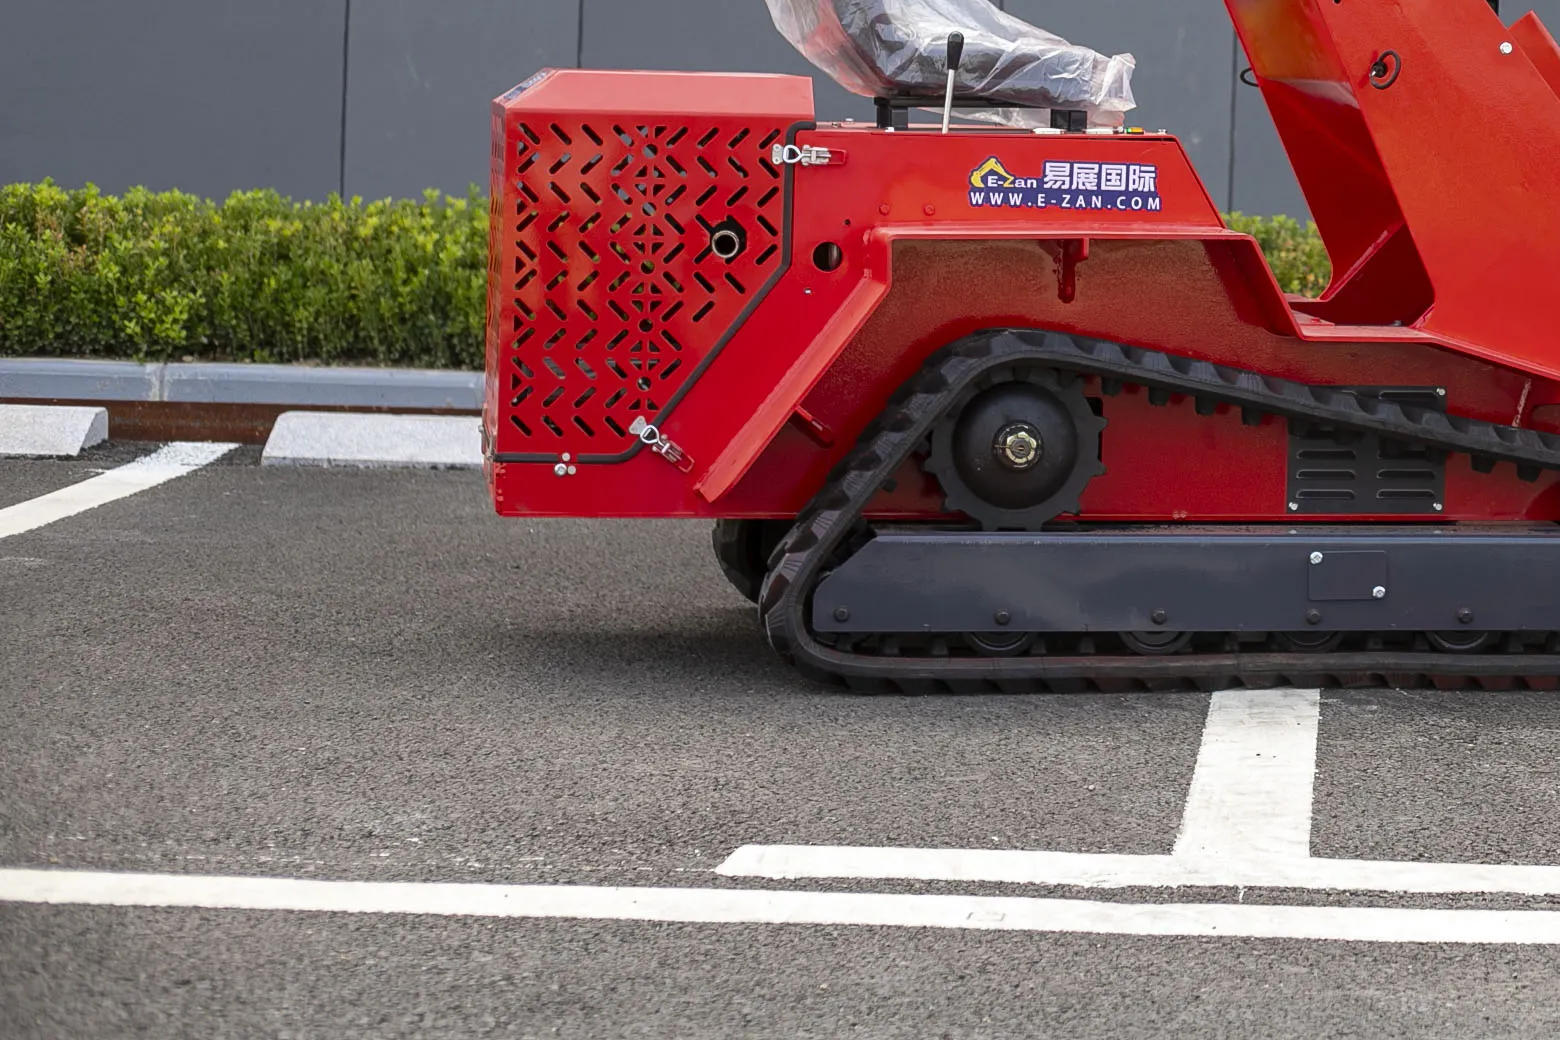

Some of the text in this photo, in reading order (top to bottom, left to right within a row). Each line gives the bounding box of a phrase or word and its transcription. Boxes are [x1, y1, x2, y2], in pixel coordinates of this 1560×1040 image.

[987, 174, 1037, 189] E-Zan
[1043, 162, 1156, 192] 易展国际
[970, 191, 1161, 210] WWW.E-ZAN.COM
